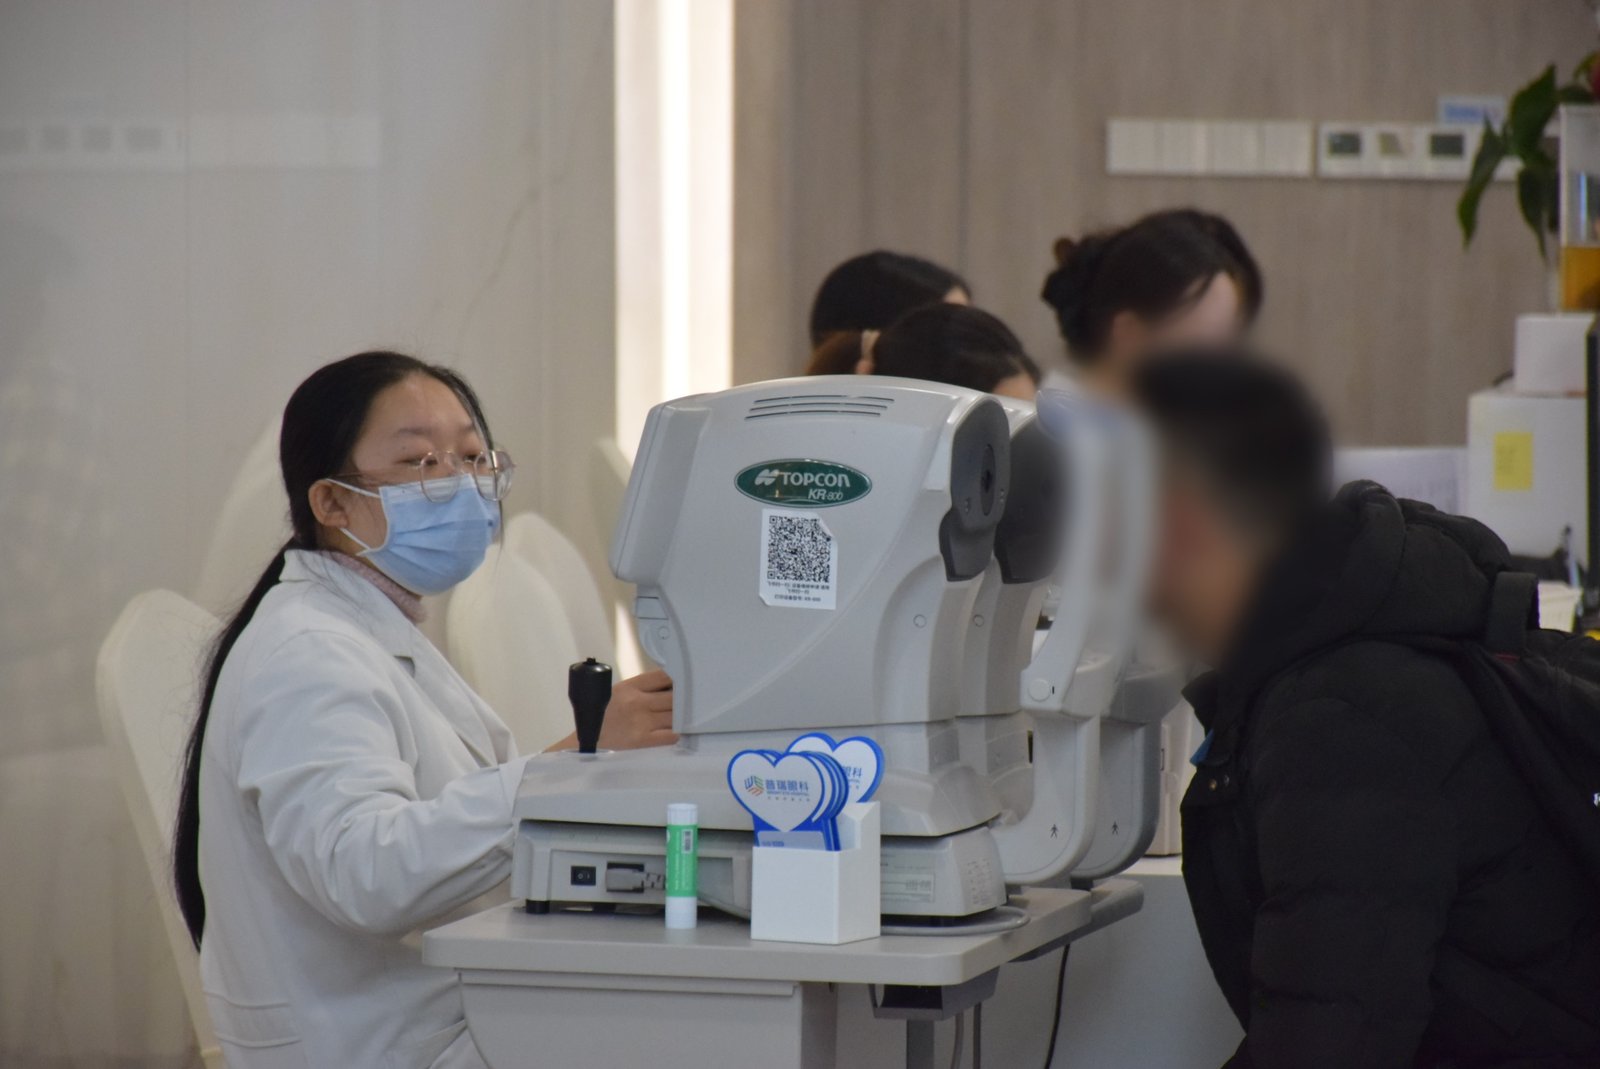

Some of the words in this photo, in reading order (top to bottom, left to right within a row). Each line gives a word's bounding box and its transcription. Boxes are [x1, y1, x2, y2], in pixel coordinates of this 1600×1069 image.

[781, 471, 851, 488] TOPCON
[765, 779, 809, 792] 普瑞眼科
